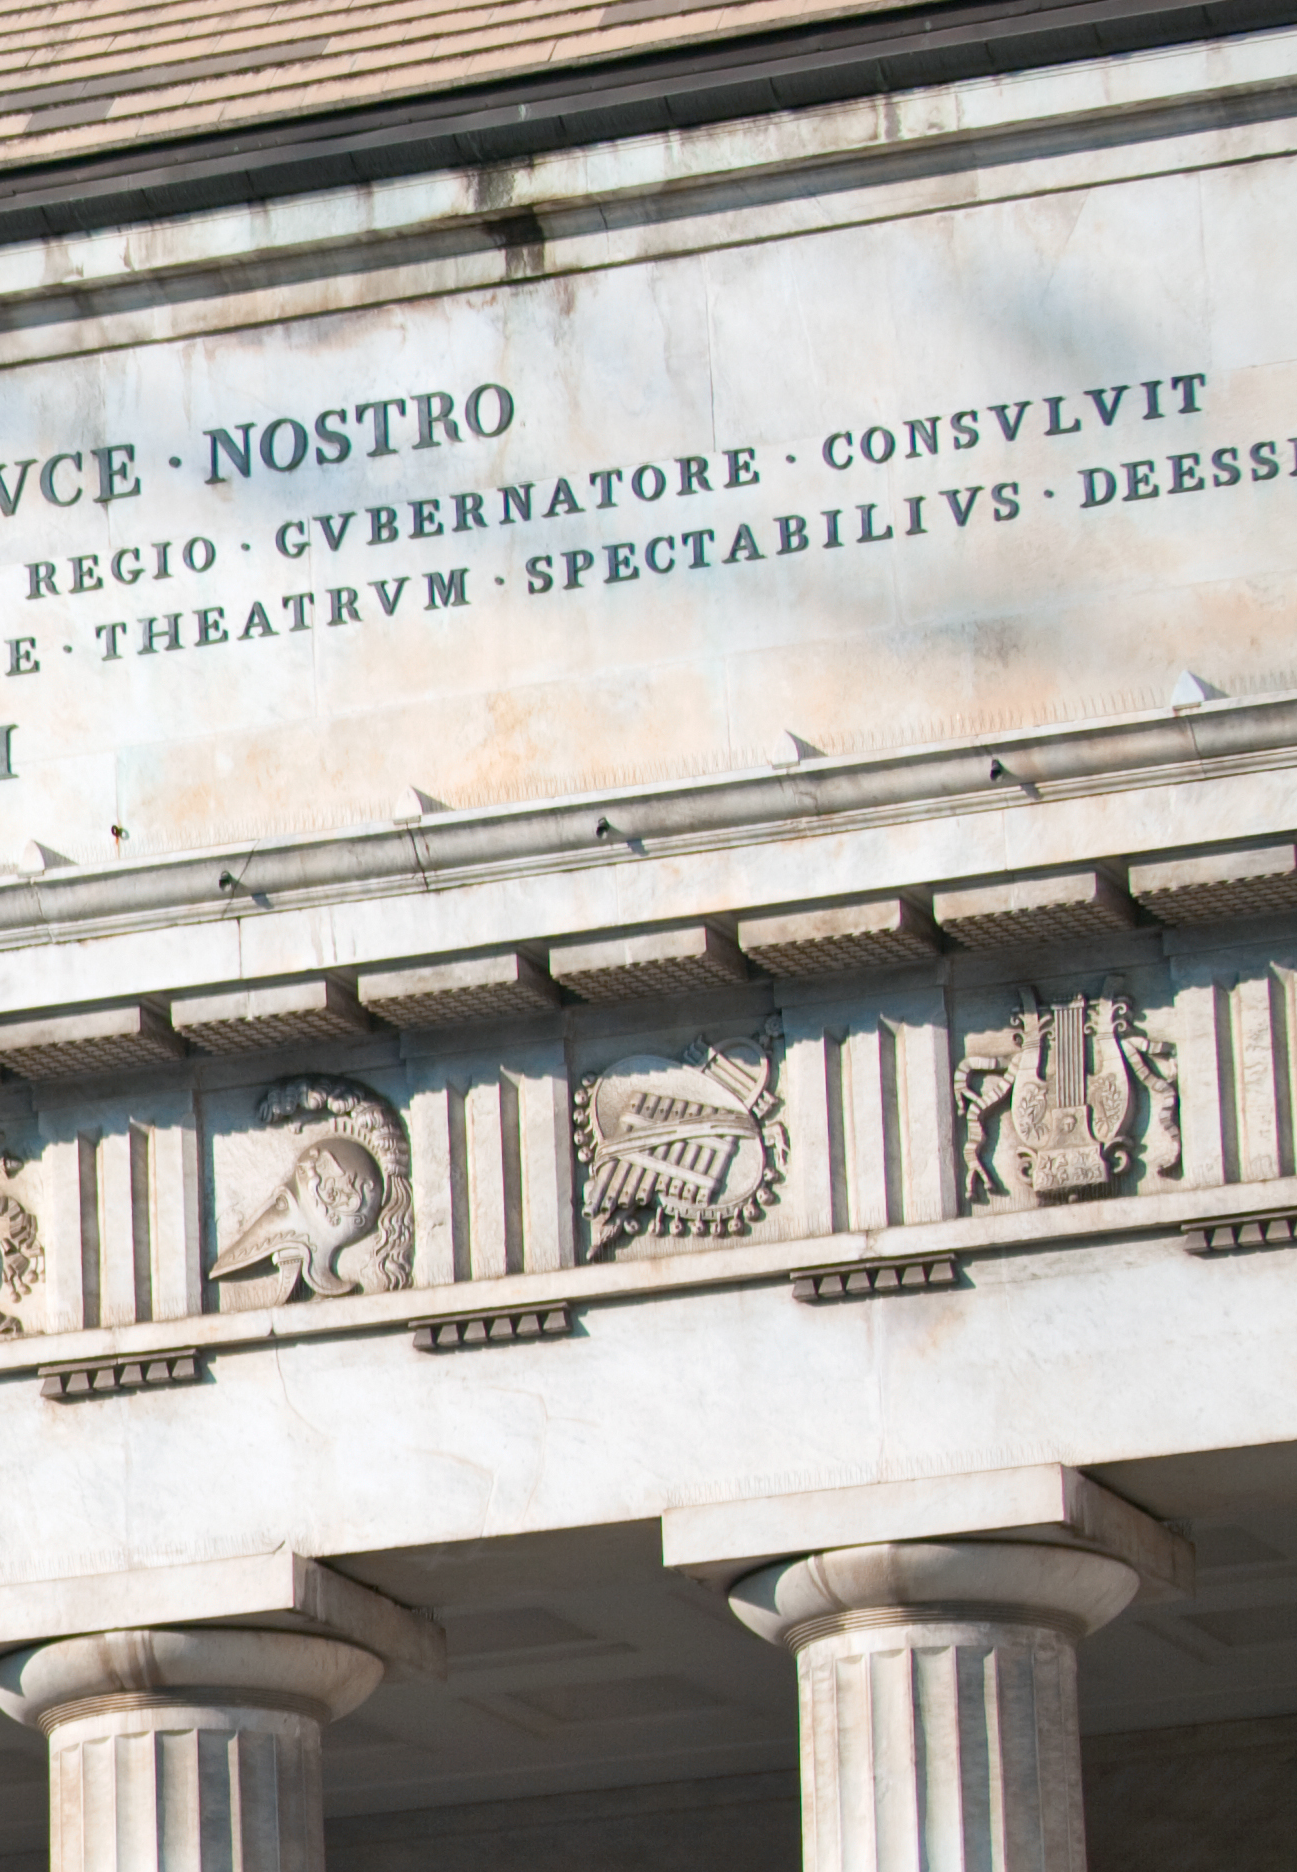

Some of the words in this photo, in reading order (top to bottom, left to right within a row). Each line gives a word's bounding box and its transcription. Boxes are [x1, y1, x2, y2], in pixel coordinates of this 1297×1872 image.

[25, 537, 216, 600] REGIO
[276, 447, 759, 558] GVBERNATORE
[822, 373, 1205, 470] CONSVLVIT
[203, 384, 514, 485] NOSTRO
[95, 568, 470, 661] THEATRVM
[526, 482, 1019, 595] SPECTABILIVS
[1077, 437, 1297, 509] DEESS
